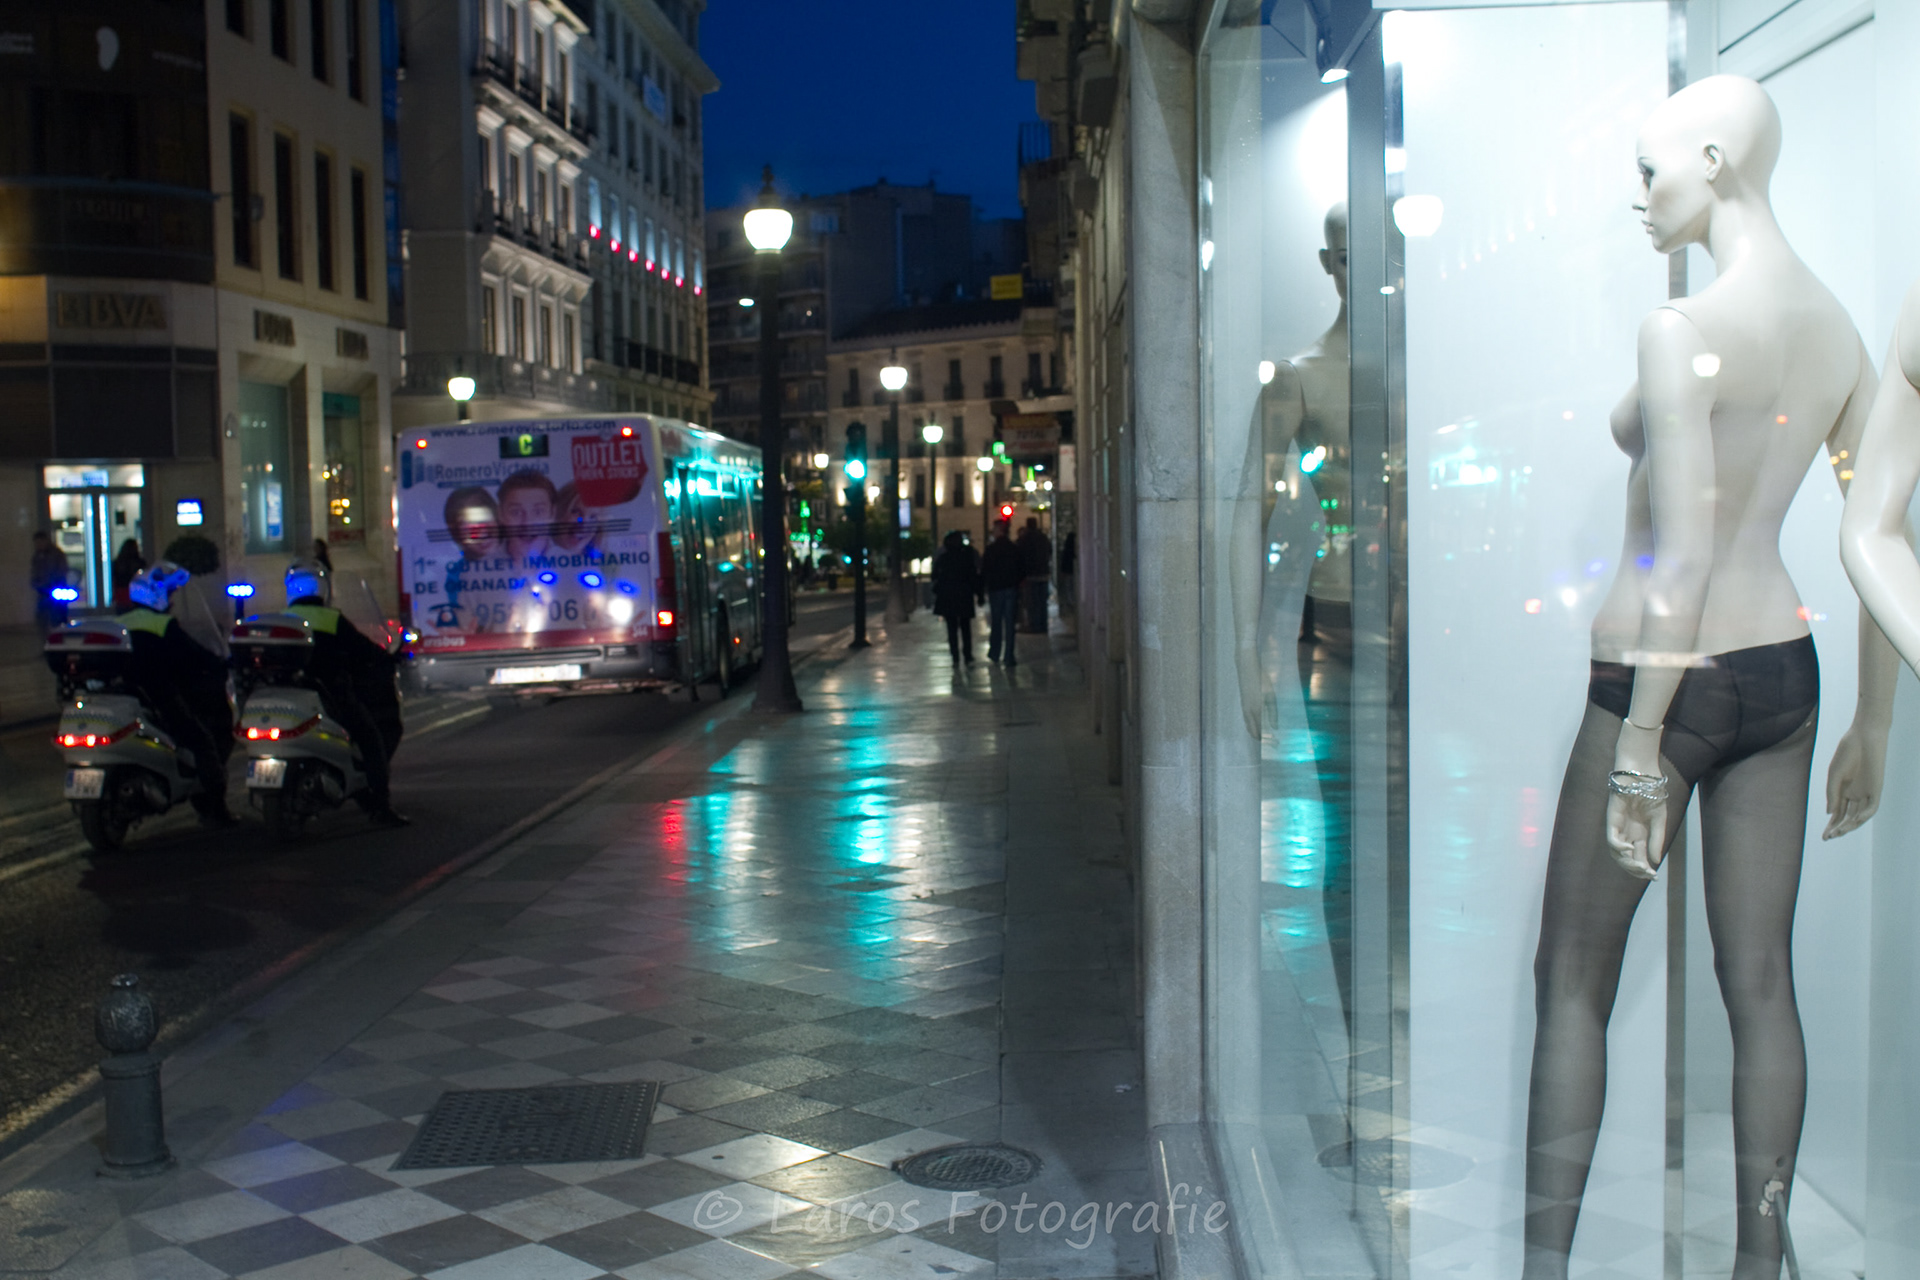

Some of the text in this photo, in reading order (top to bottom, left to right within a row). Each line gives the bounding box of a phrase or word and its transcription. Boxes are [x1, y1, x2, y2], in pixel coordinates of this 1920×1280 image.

[57, 292, 167, 330] BBVA
[518, 434, 533, 456] C
[573, 441, 642, 468] OUTLET
[445, 558, 514, 574] OUTLET
[522, 551, 651, 569] INMOBILIARIO
[415, 581, 438, 595] DE
